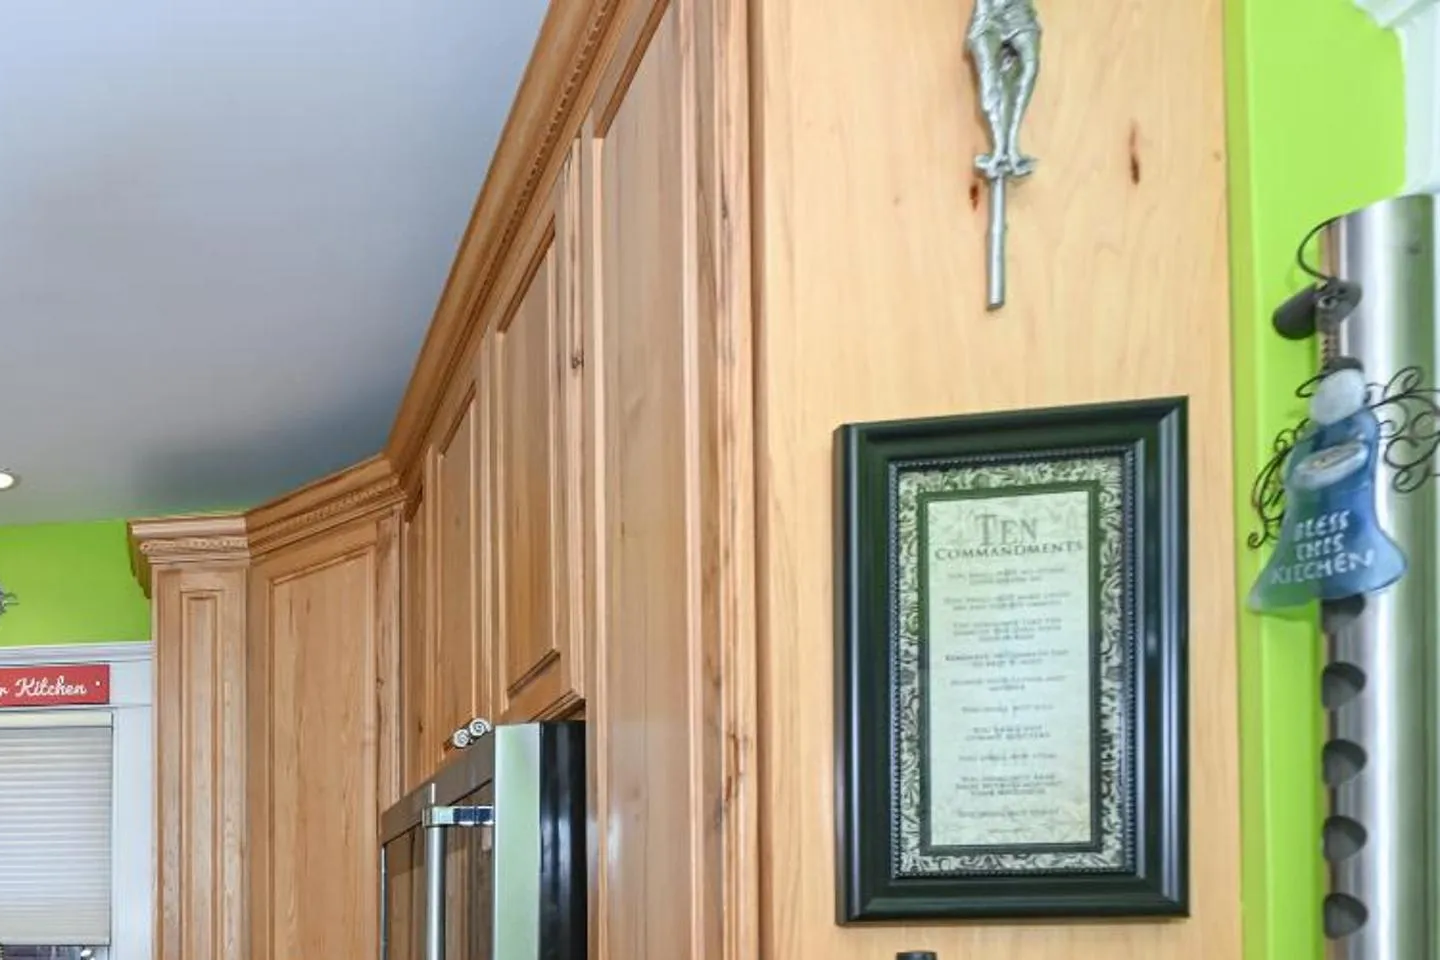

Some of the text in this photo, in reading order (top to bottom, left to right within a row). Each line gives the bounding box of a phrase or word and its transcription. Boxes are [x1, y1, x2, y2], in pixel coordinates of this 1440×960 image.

[974, 513, 1038, 546] TEN
[1294, 510, 1351, 541] BLESS
[934, 539, 1085, 560] COMMANDMENTS
[1271, 548, 1375, 585] KITCHEN
[15, 675, 87, 698] Kitchen
